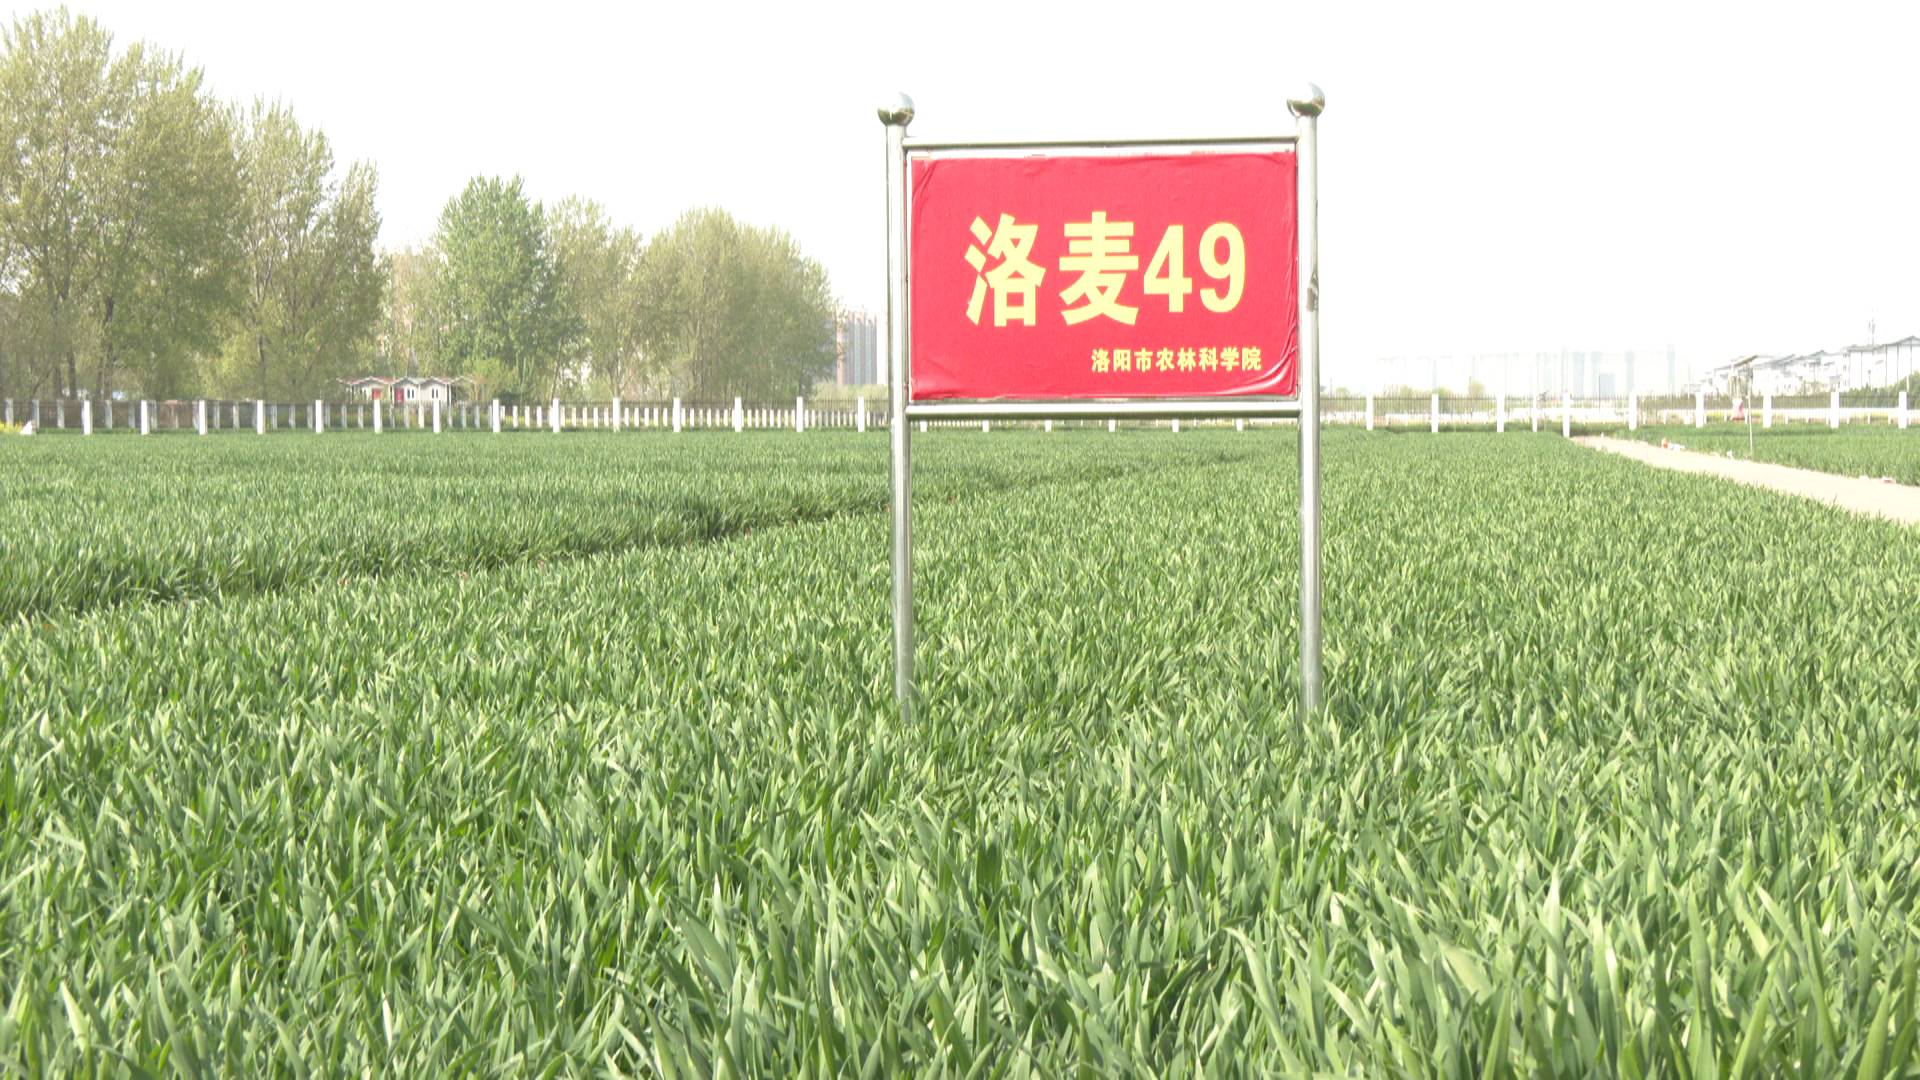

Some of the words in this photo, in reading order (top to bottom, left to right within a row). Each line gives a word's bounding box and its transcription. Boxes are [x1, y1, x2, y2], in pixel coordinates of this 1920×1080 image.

[964, 210, 1247, 327] 洛麦49
[1091, 346, 1262, 373] 洛阳市农林科学院
